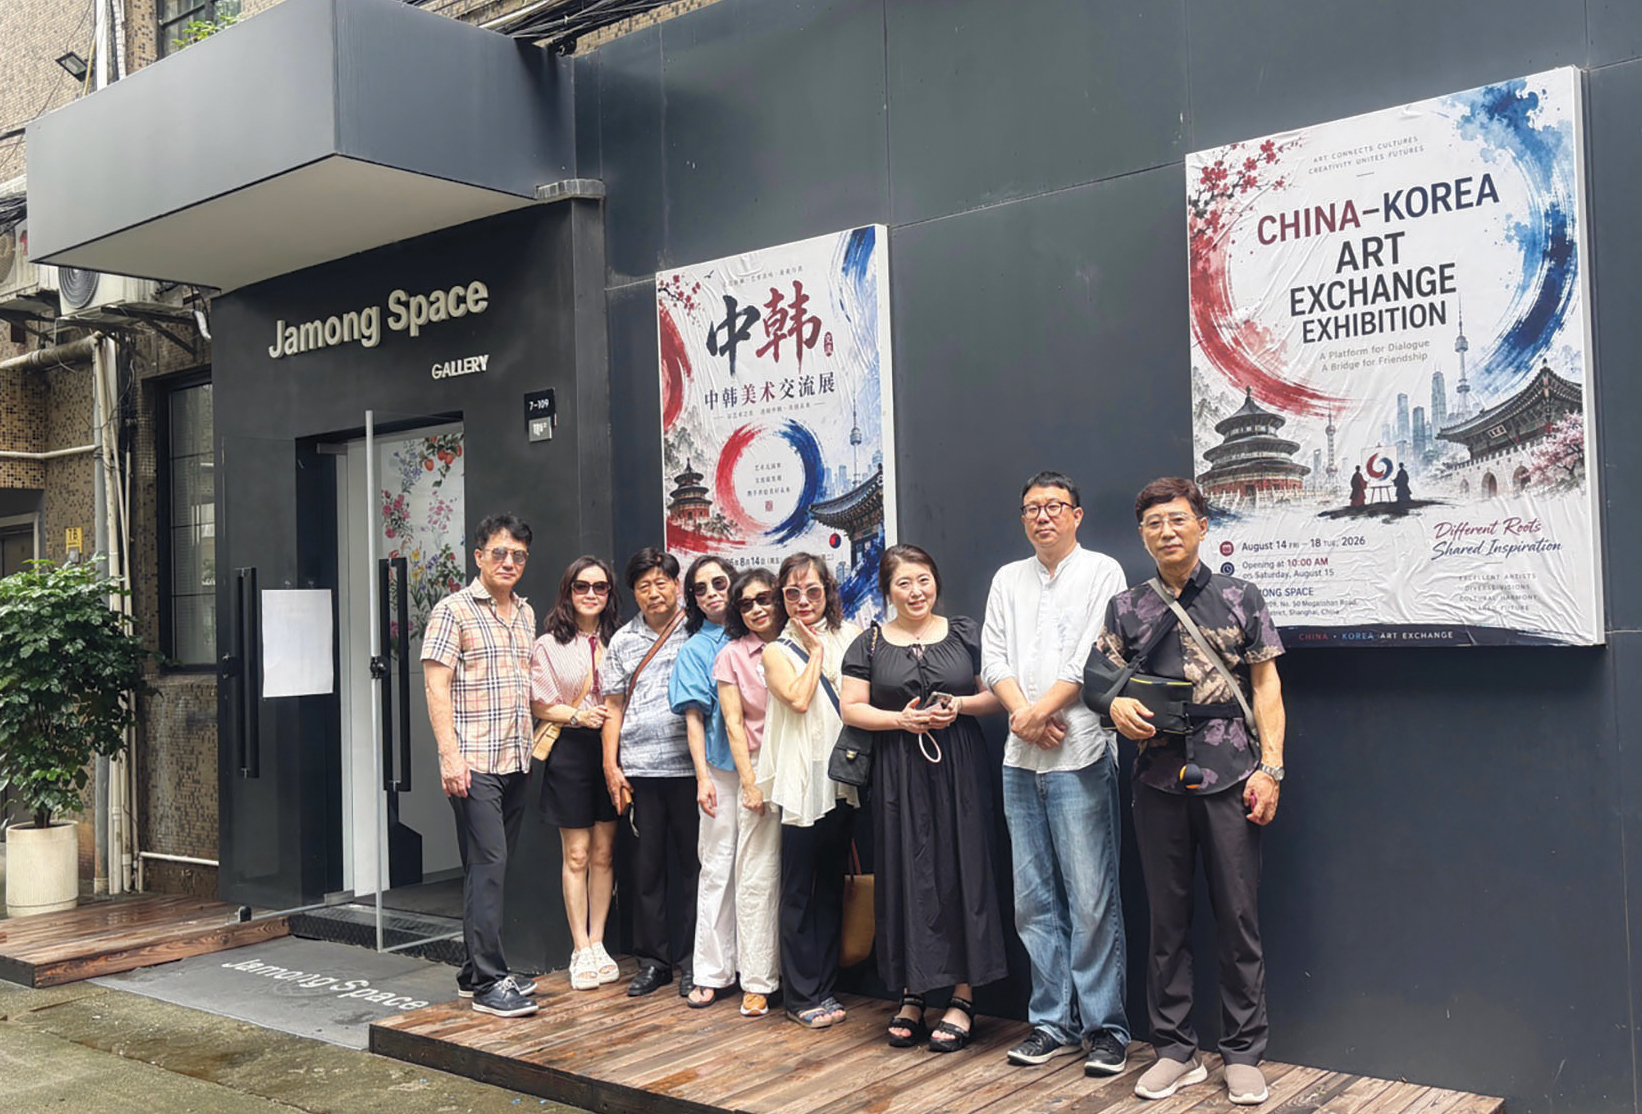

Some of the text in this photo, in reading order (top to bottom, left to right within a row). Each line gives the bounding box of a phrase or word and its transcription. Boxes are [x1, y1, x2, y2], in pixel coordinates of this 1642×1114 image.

[1308, 145, 1425, 175] CREATIVITY UNITES FUTURES
[1313, 135, 1419, 163] ART CONNECTS CULTURES
[1335, 230, 1406, 274] ART
[1289, 261, 1457, 317] EXCHANGE
[268, 280, 489, 359] Jamong Space
[705, 279, 822, 376] 中韩
[1301, 299, 1447, 344] EXHIBITION
[1328, 346, 1369, 360] Platform
[1371, 344, 1385, 354] for
[1387, 340, 1430, 352] Dialogue
[1331, 360, 1360, 371] Bridge
[1362, 358, 1376, 367] for
[1378, 352, 1428, 366] Friendship
[431, 354, 490, 380] GALLERY
[704, 371, 835, 411] 中韩美术交流展
[1433, 517, 1542, 541] Different Roots
[1241, 541, 1273, 553] August
[1276, 540, 1287, 549] 14
[1310, 538, 1322, 548] 18
[1341, 536, 1366, 546] 2026
[1430, 537, 1562, 561] Shared Inspiration
[1242, 557, 1329, 570] Opening at 10:00 AM
[1255, 569, 1292, 580] Saturday,
[1293, 569, 1322, 579] August
[1324, 568, 1335, 576] 15
[1284, 586, 1315, 597] SPACE
[1298, 630, 1454, 641] CHINA KOREA ART EXCHANGE
[221, 959, 430, 1011] Jamong Space
